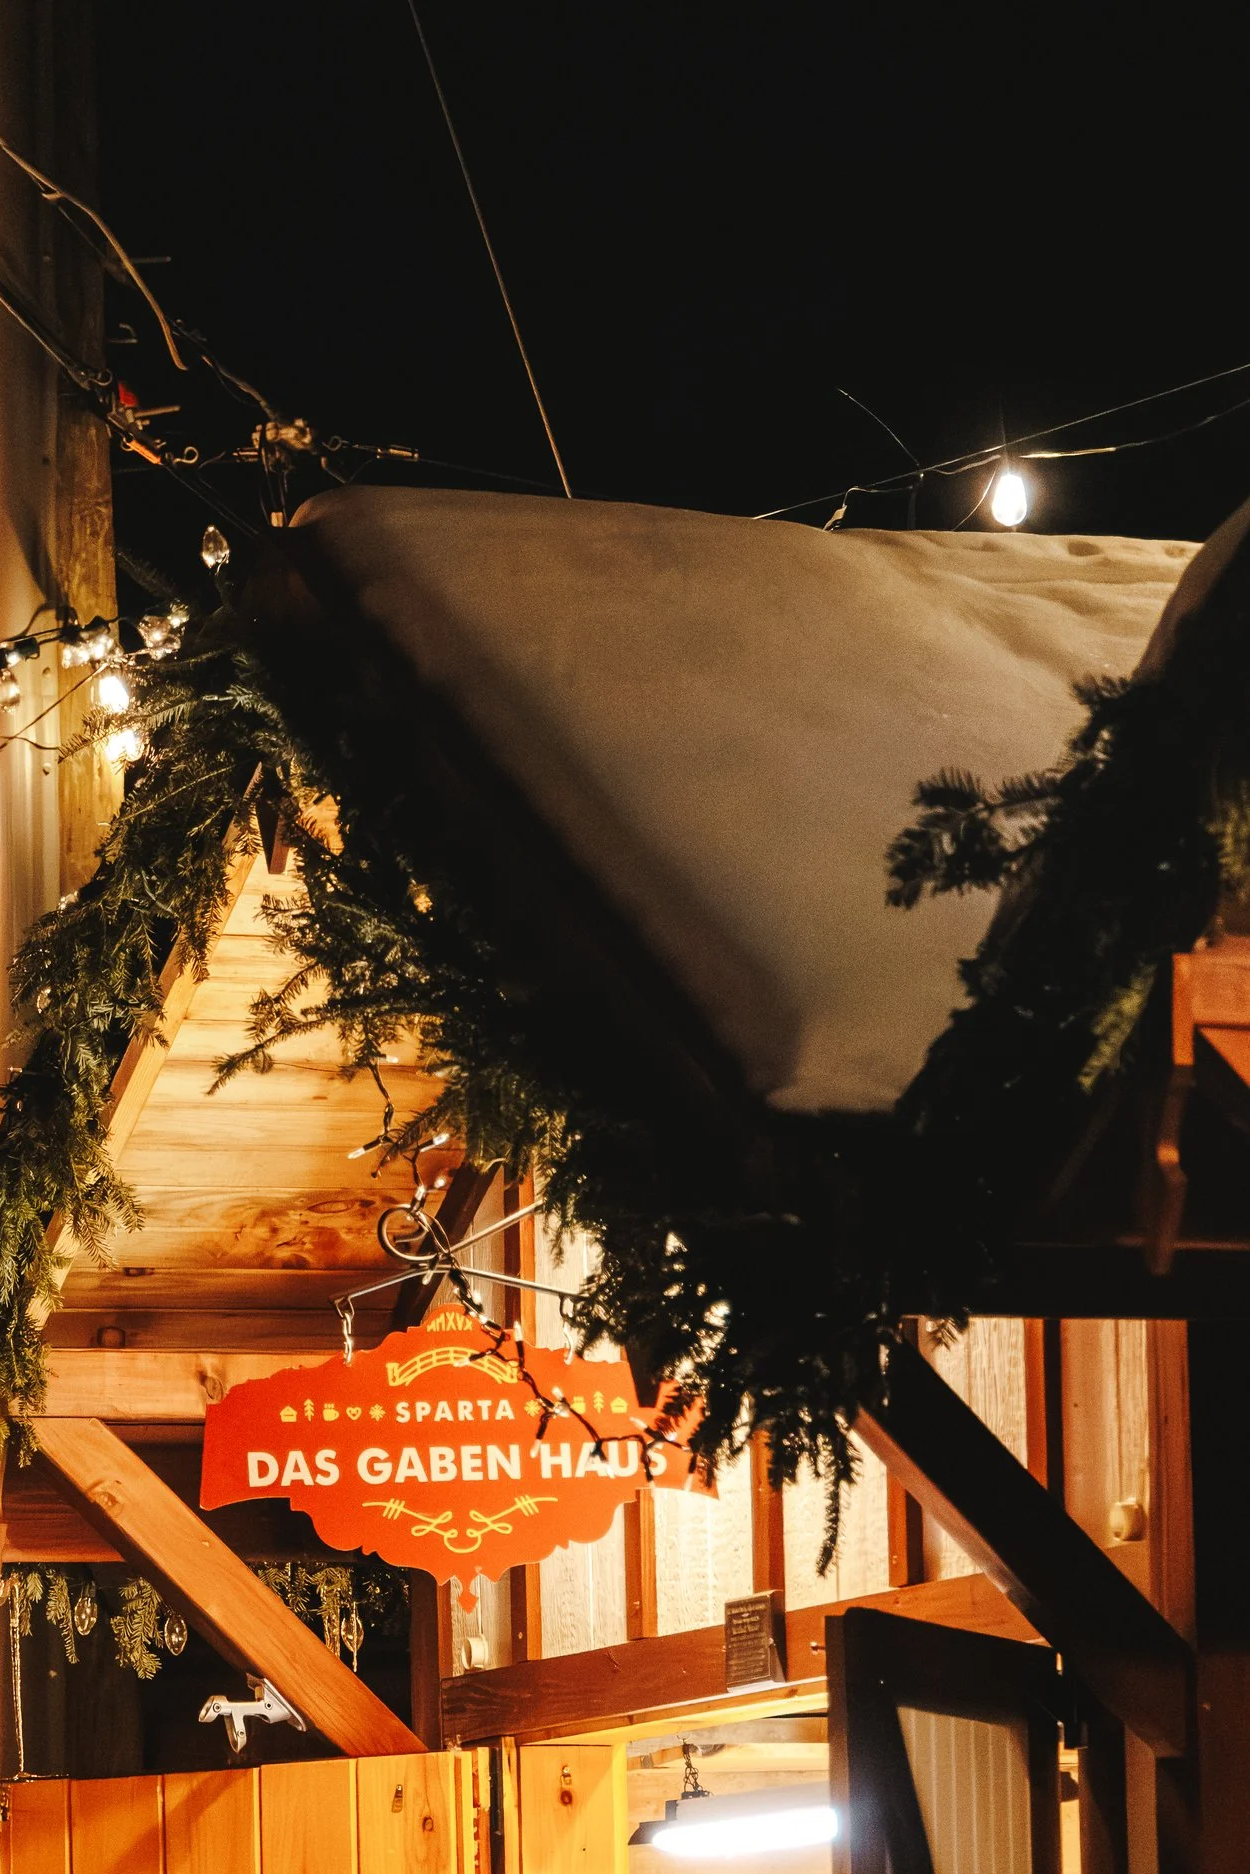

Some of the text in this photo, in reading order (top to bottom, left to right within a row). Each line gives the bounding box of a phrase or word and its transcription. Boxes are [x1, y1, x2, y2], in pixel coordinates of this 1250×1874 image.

[396, 1399, 515, 1423] SPARTA
[247, 1440, 668, 1488] DAS GABEN HAUS
